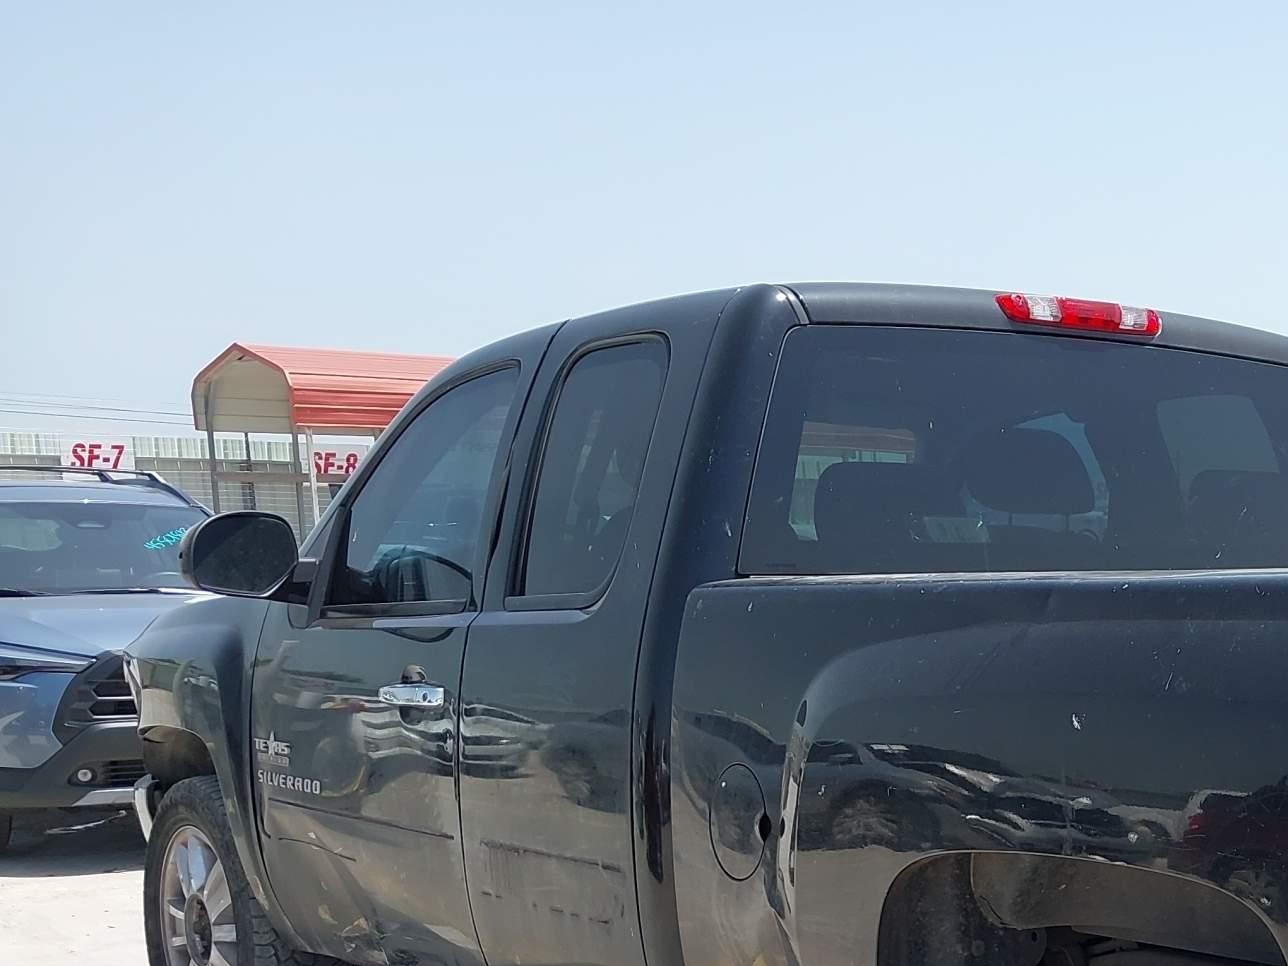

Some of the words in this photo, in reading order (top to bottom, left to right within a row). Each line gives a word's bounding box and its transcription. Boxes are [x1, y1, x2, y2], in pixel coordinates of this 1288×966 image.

[71, 443, 125, 469] SF-7
[313, 452, 358, 474] SF-8
[254, 732, 290, 755] TEXAS
[257, 769, 321, 795] SILVERADO
